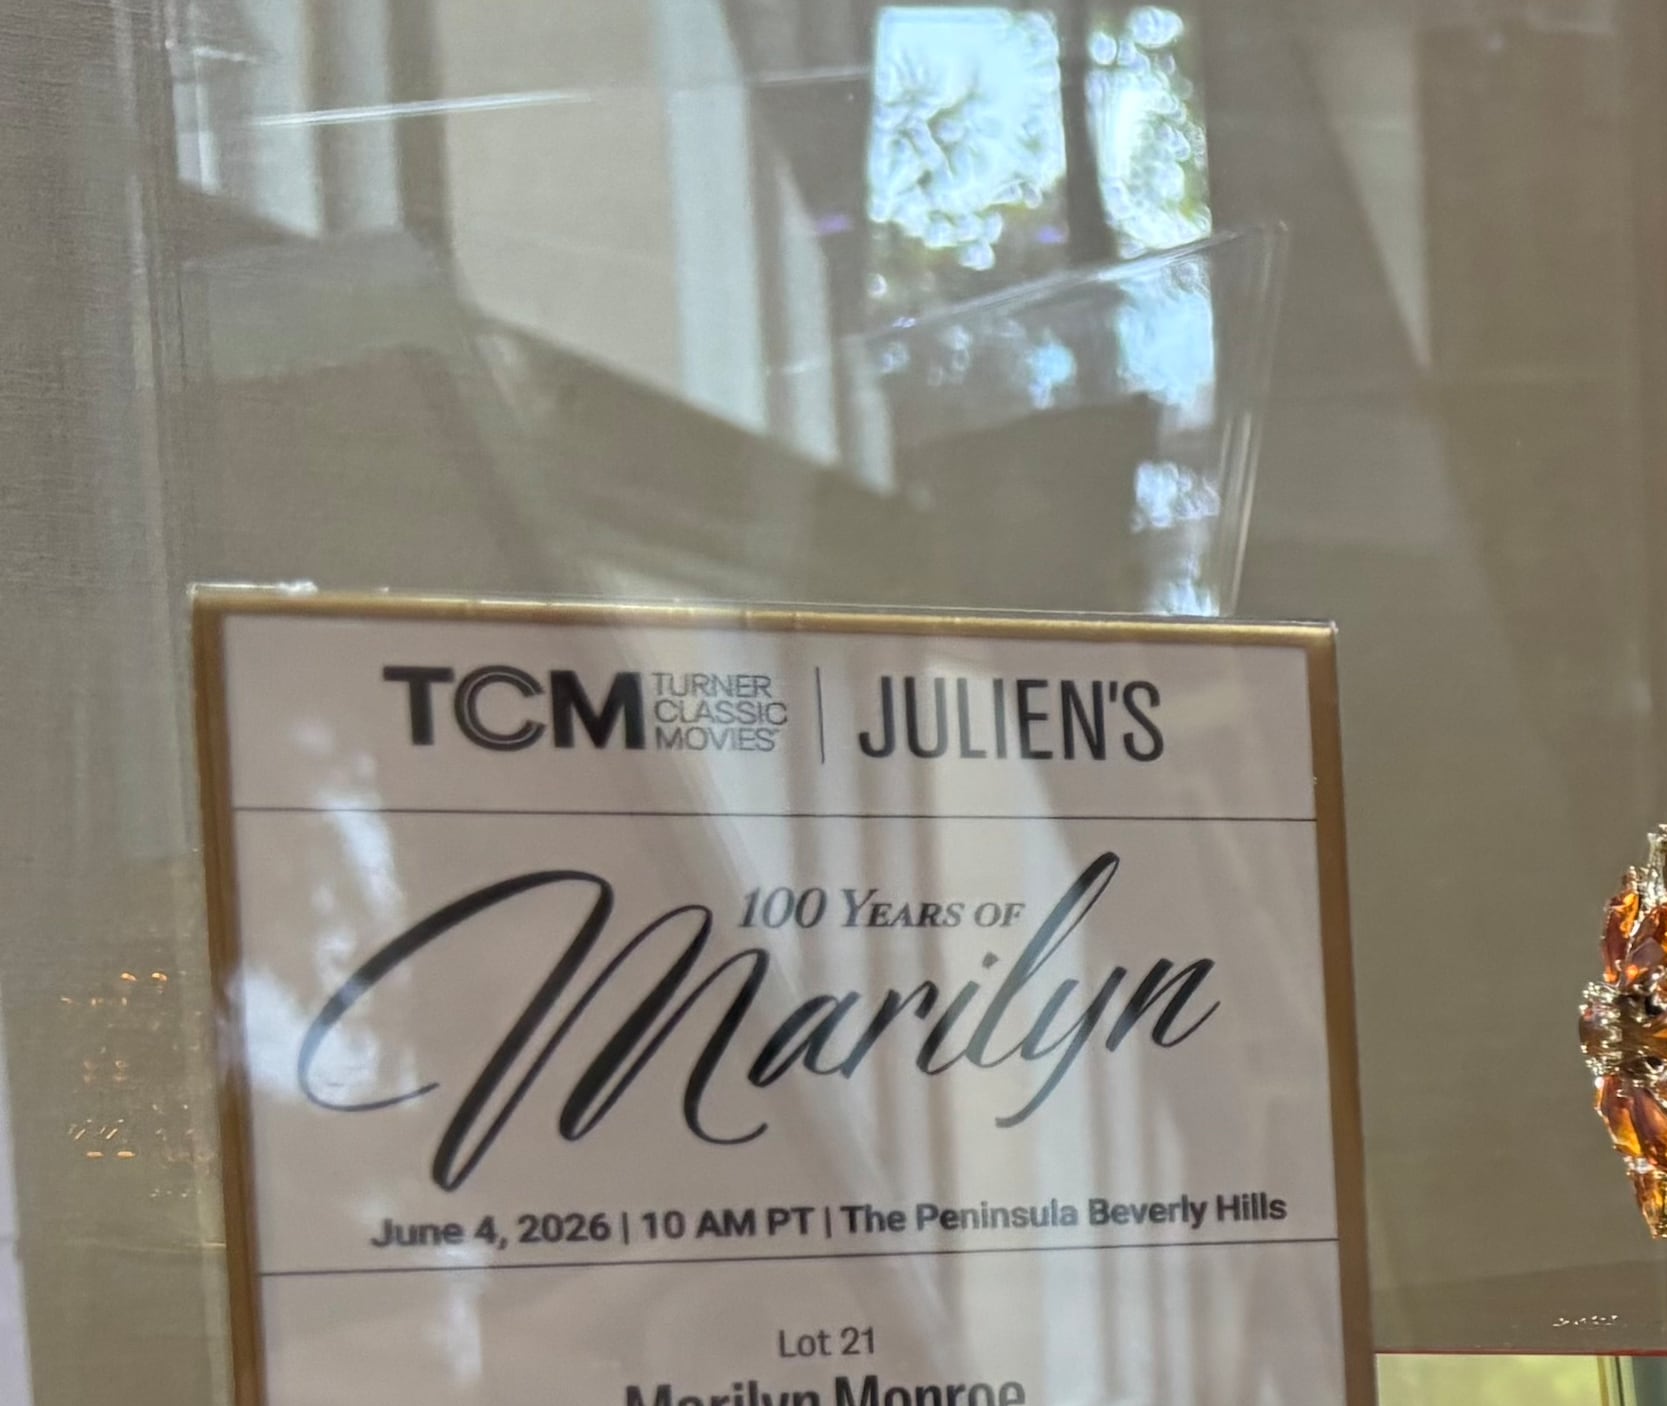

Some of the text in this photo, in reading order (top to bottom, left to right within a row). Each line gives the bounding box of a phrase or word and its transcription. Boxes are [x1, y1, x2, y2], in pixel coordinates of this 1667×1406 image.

[652, 671, 772, 698] TURNER
[383, 664, 646, 751] TCM
[653, 699, 788, 726] CLASSIC
[860, 675, 1165, 763] JULIEN'S
[655, 726, 777, 753] MOVIES
[739, 886, 827, 929] 100
[297, 850, 1222, 1192] Marilyn
[370, 1217, 465, 1249] June
[474, 1215, 507, 1250] 4,
[518, 1212, 612, 1244] 2026
[642, 1210, 686, 1239] 10
[695, 1208, 757, 1238] AM
[767, 1206, 816, 1236] PT
[841, 1204, 907, 1233] The
[916, 1198, 1080, 1231] Peninsula
[1088, 1195, 1208, 1230] Beverly
[1216, 1191, 1288, 1222] Hills
[778, 1326, 876, 1359] Lot 21
